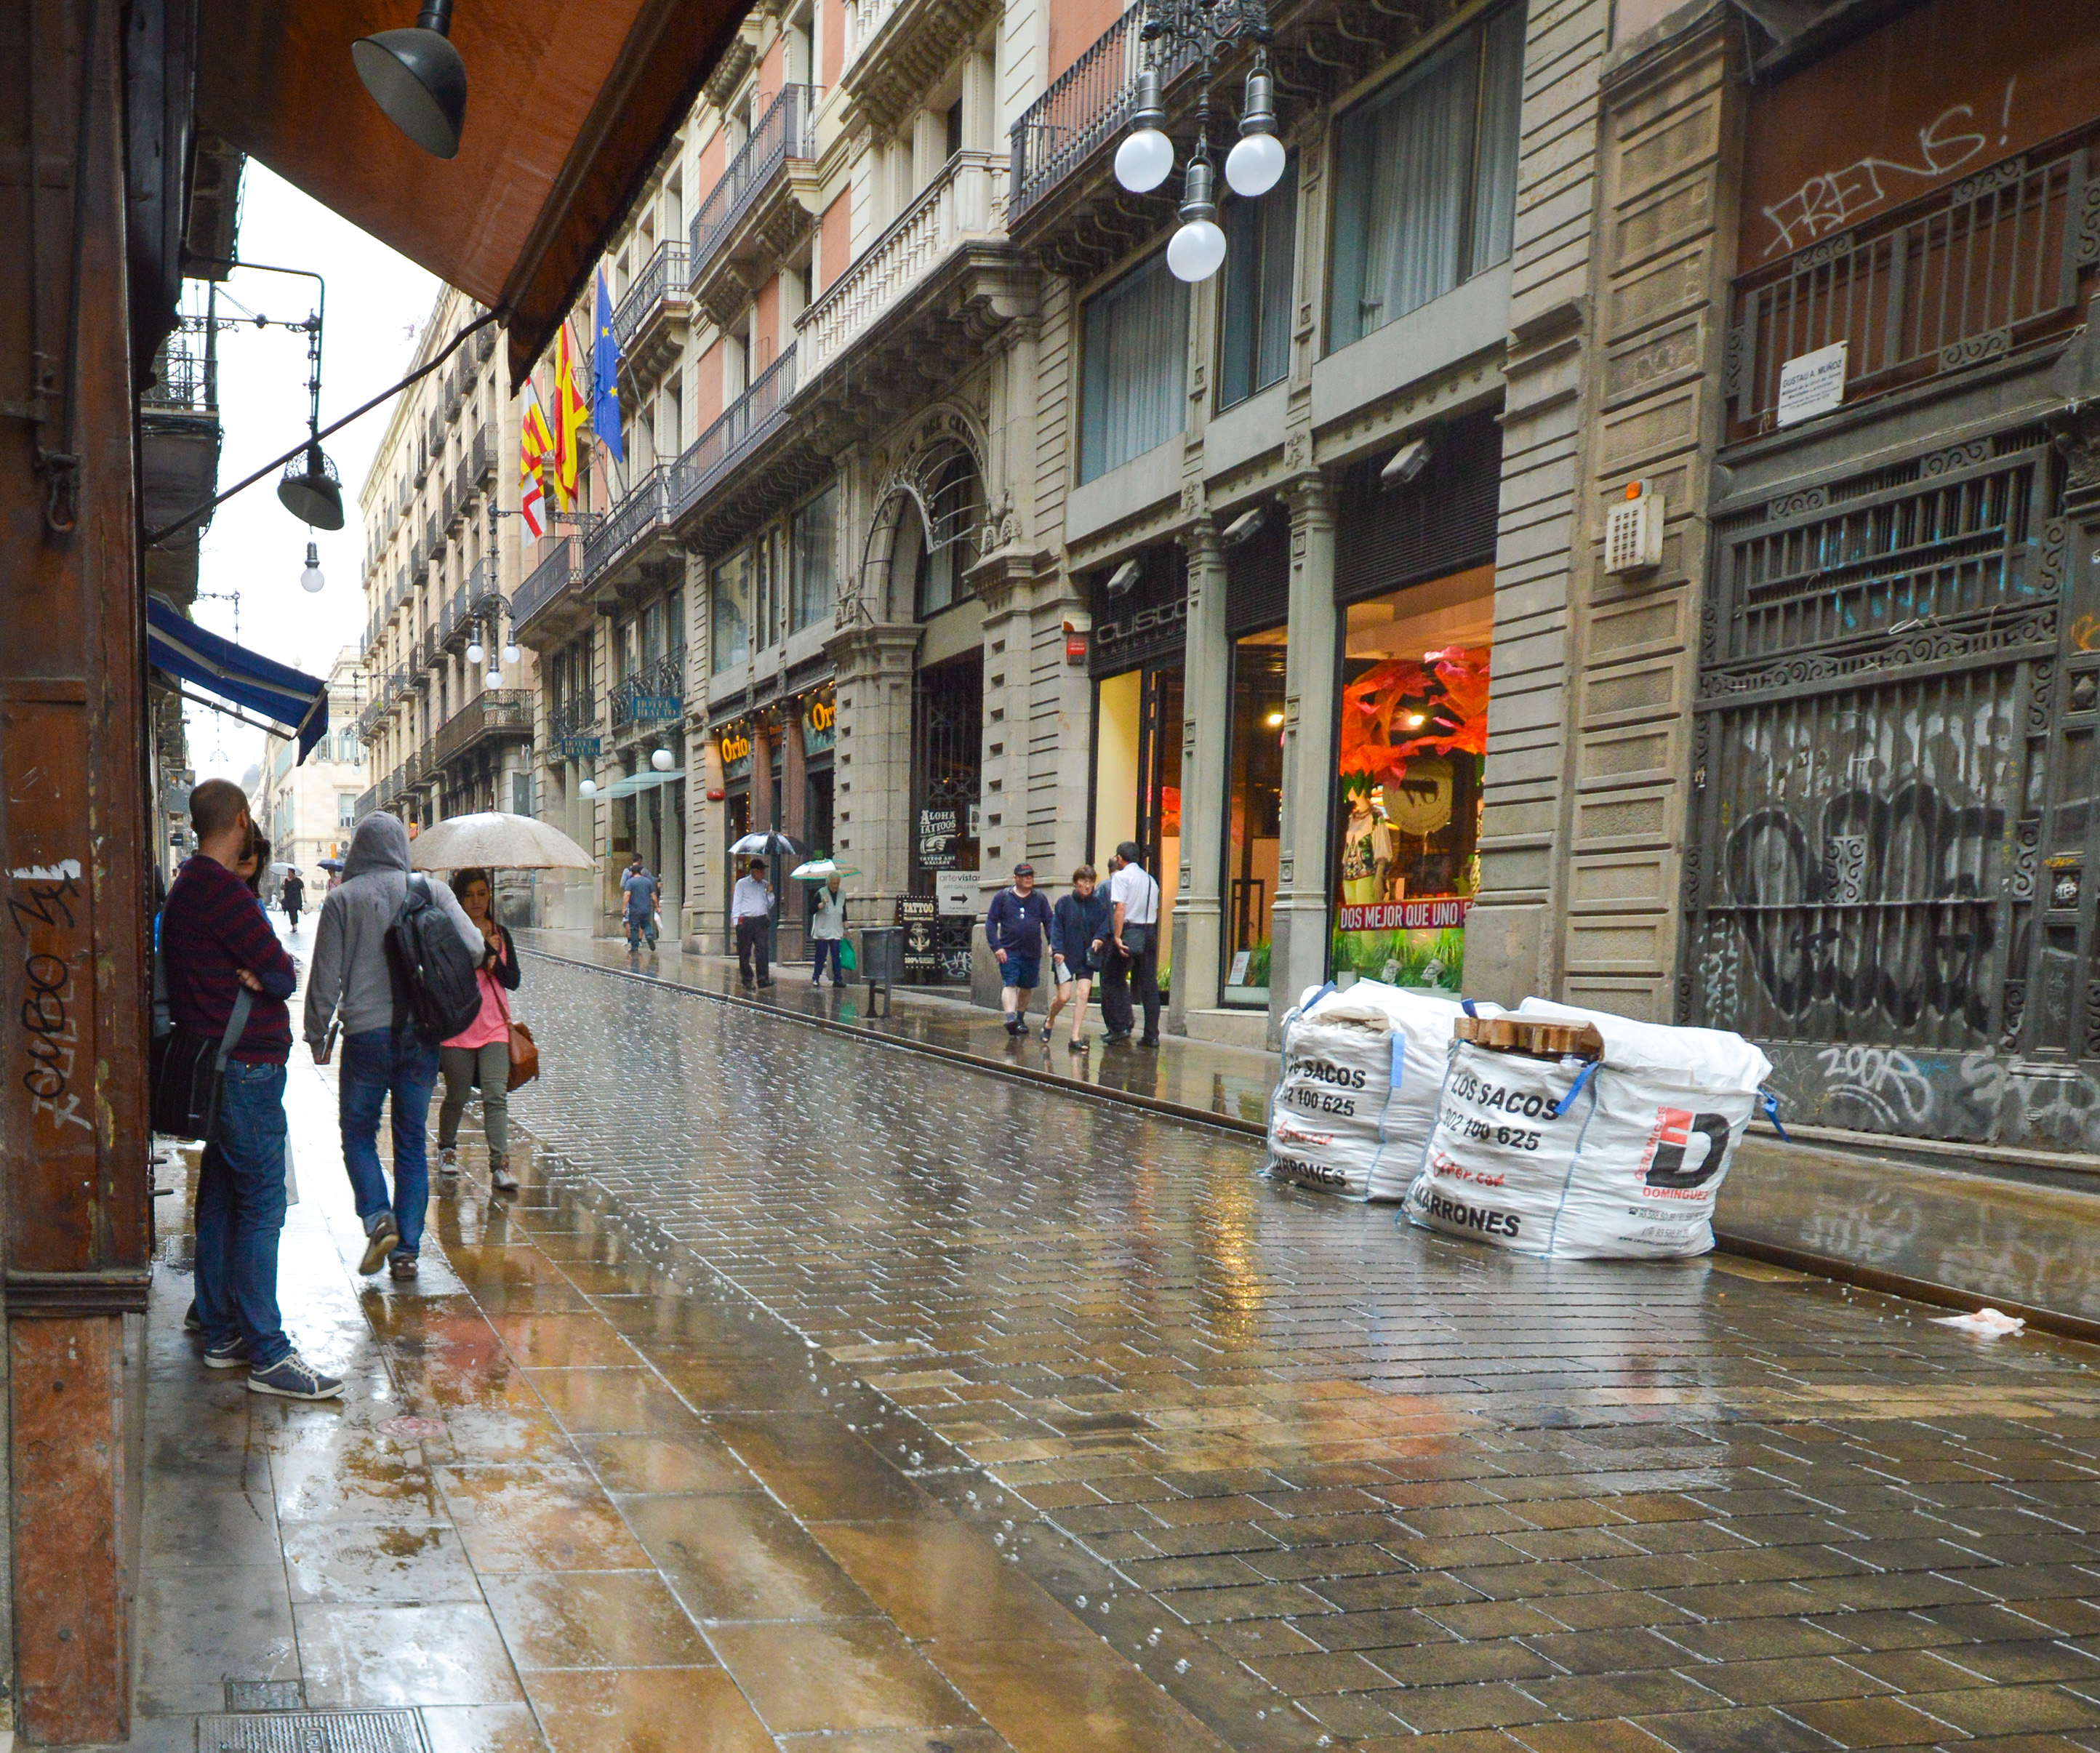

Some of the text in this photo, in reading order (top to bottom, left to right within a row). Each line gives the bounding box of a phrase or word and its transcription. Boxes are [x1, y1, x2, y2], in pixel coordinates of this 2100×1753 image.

[1782, 372, 1809, 388] GUSTAU
[1818, 359, 1843, 374] MUÑOZ
[637, 708, 676, 717] RIALTO
[812, 698, 836, 731] Ori
[721, 734, 748, 762] Orio
[920, 809, 955, 825] ALOHA
[920, 819, 956, 835] TATTOOS
[903, 902, 934, 914] TATTOO
[1340, 907, 1362, 928] DOS
[1364, 905, 1403, 928] MEJOR
[1406, 903, 1430, 927] QUE
[1432, 902, 1458, 926] UNO
[1303, 1059, 1366, 1088] SACOS
[1298, 1088, 1319, 1110] 100
[1323, 1096, 1355, 1117] 625
[1451, 1072, 1561, 1121] LOS SACOS
[1464, 1116, 1491, 1140] 100
[1497, 1126, 1542, 1151] 625
